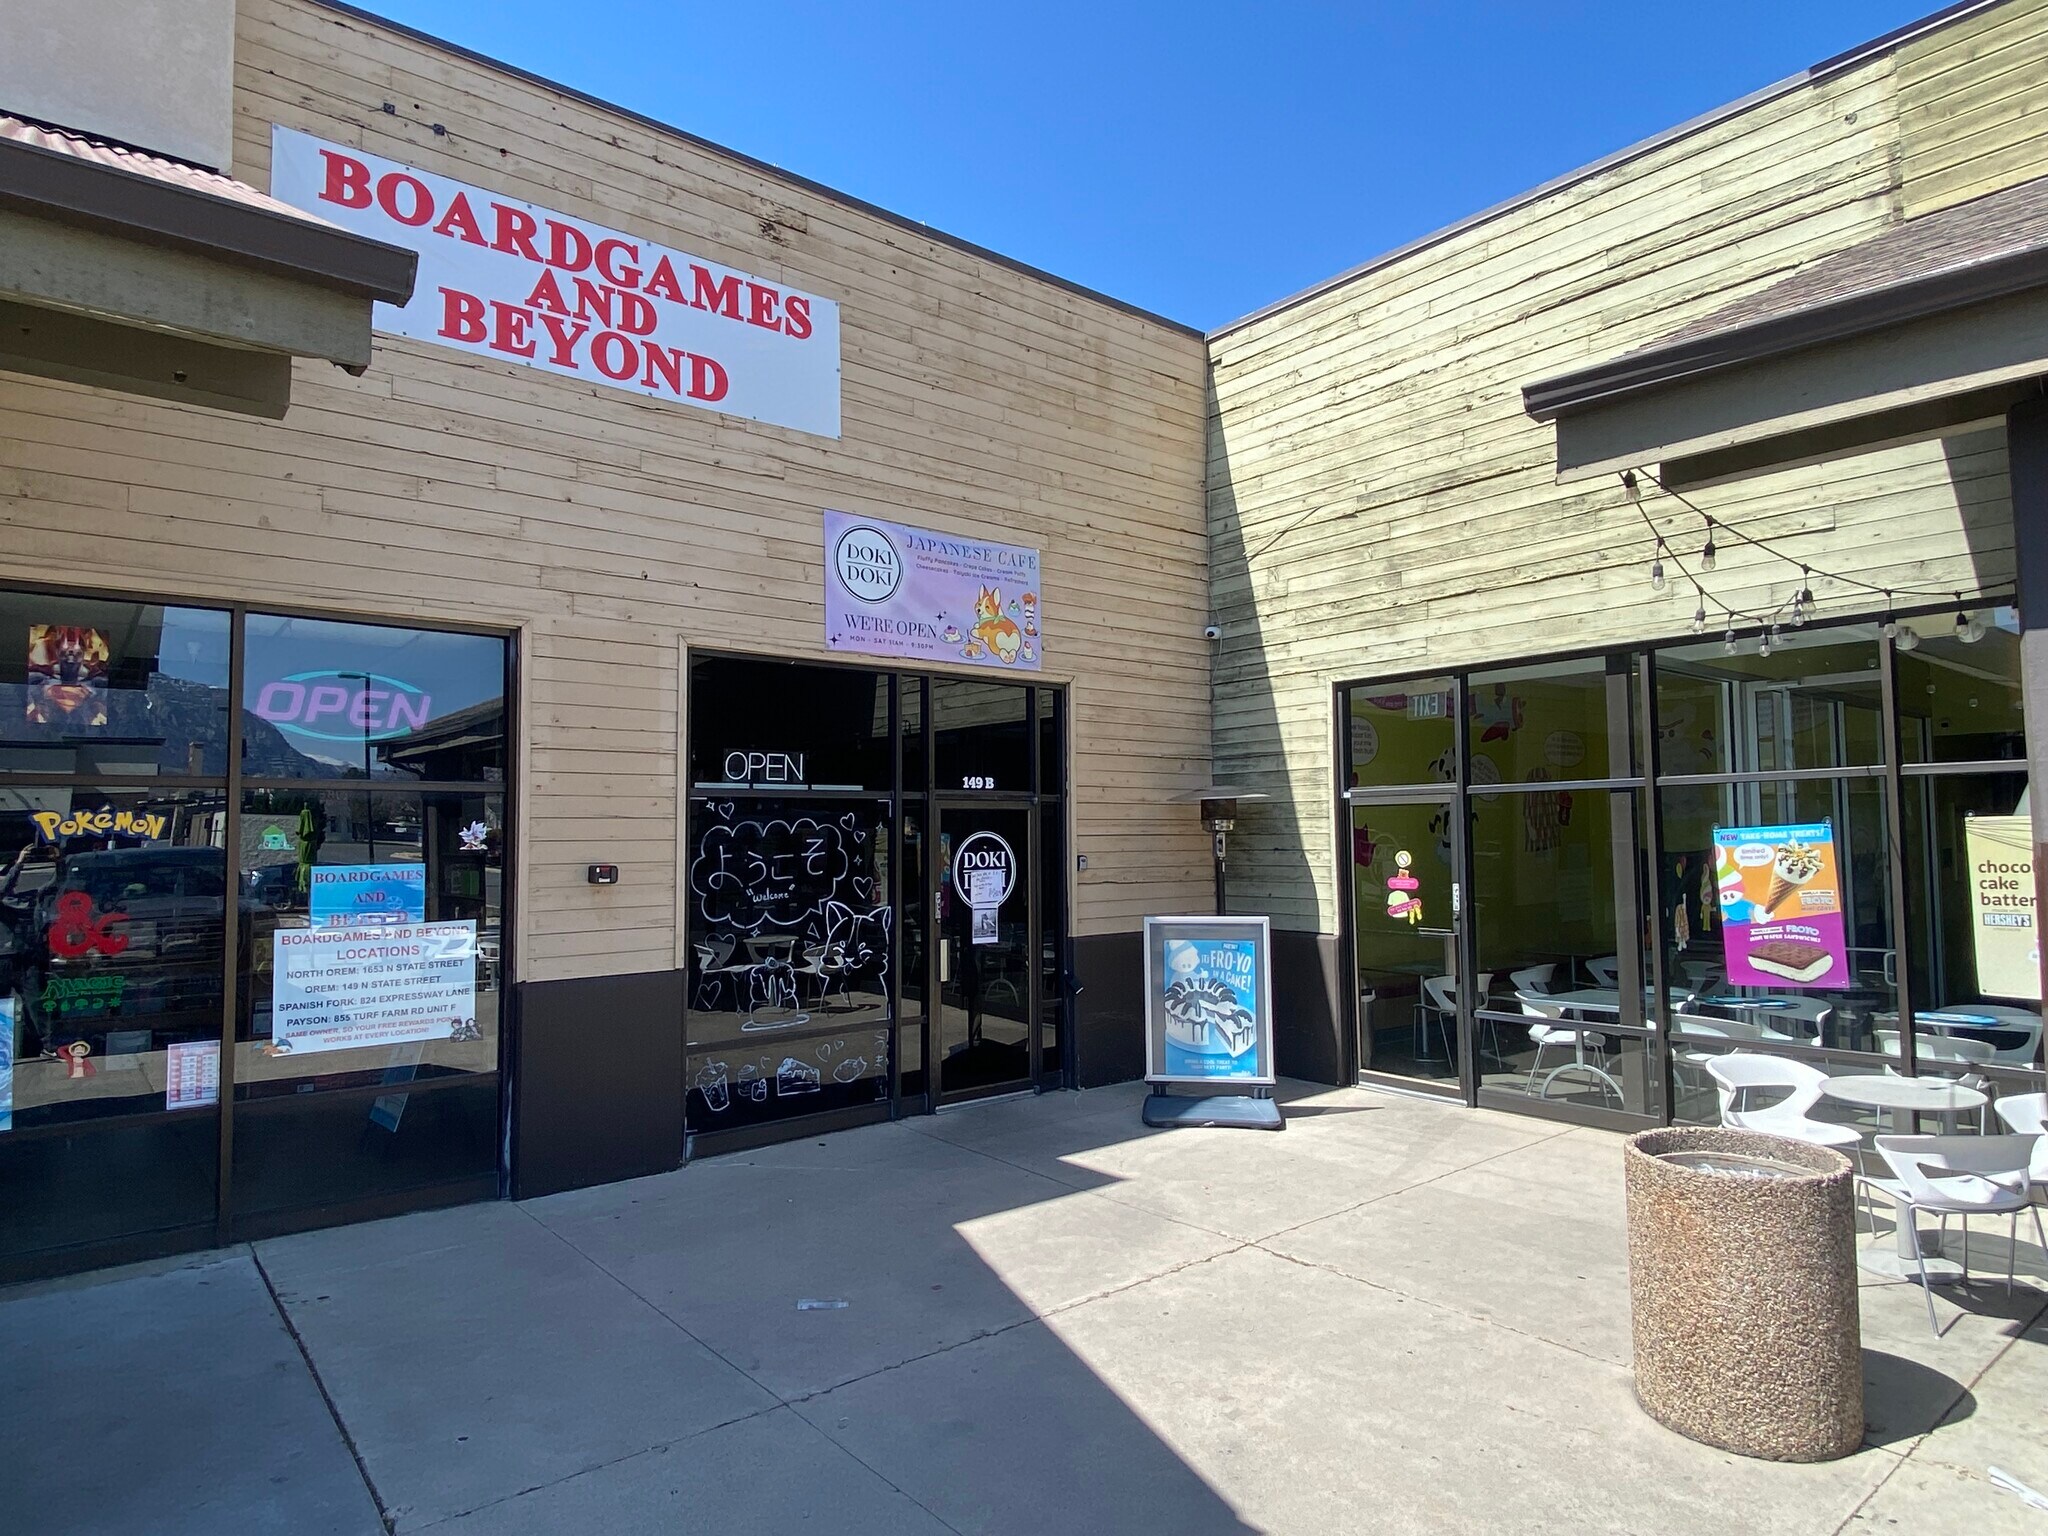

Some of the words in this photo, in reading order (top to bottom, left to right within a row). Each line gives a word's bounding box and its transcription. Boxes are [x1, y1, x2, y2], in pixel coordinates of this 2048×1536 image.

[318, 149, 812, 340] BOARDGAMES
[526, 268, 658, 336] AND
[437, 287, 729, 402] BEYOND
[847, 543, 892, 565] DOKI
[907, 535, 992, 562] JAPANESE
[998, 551, 1036, 570] CAFE
[848, 565, 892, 586] DOKI
[844, 614, 893, 634] WE'RE
[896, 620, 937, 638] OPEN
[256, 681, 431, 730] OPEN
[725, 752, 803, 781] OPEN
[962, 776, 984, 789] 149
[985, 777, 995, 789] B
[1720, 833, 1738, 841] NEW
[708, 838, 826, 890] ようこそ
[963, 851, 1006, 869] DOKI
[1978, 860, 2031, 873] choco
[314, 870, 424, 884] BOARDGAMES
[1979, 876, 2019, 890] cake
[354, 891, 386, 903] AND
[1980, 892, 2037, 907] batter
[1785, 924, 1820, 936] FROYO
[1983, 914, 2030, 926] HERSHEY'S
[281, 931, 380, 946] BOARDGAMES
[337, 945, 420, 960] LOCATIONS
[1210, 950, 1252, 973] FRO-YO
[286, 969, 323, 979] NORTH
[326, 967, 359, 977] OREM:
[363, 965, 384, 974] 1653
[386, 964, 394, 972] N
[396, 962, 426, 971] STATE
[428, 959, 464, 969] STREET
[305, 984, 339, 994] OREM:
[342, 982, 359, 990] 149
[361, 981, 368, 989] N
[371, 979, 402, 989] STATE
[404, 975, 442, 986] STREET
[1225, 970, 1252, 994] CAKE!
[278, 1000, 324, 1012] SPANISH
[326, 999, 357, 1008] FORK:
[360, 996, 376, 1004] 824
[379, 990, 444, 1003] EXPRESSWAY
[446, 987, 471, 997] LANE
[286, 1016, 332, 1027] PAYSON:
[334, 1014, 351, 1023] 855
[353, 1011, 379, 1020] TURF
[381, 1008, 409, 1018] FARM
[411, 1007, 425, 1015] RD
[427, 1004, 449, 1013] UNIT
[451, 1003, 457, 1011] F
[285, 1030, 308, 1039] SAME
[355, 1022, 376, 1031] YOUR
[377, 1021, 397, 1030] FREE
[398, 1018, 435, 1027] REWARDS
[323, 1035, 352, 1043] WORKS
[354, 1033, 363, 1041] AT
[365, 1030, 391, 1039] EVERY
[391, 1027, 430, 1036] LOCATION!
